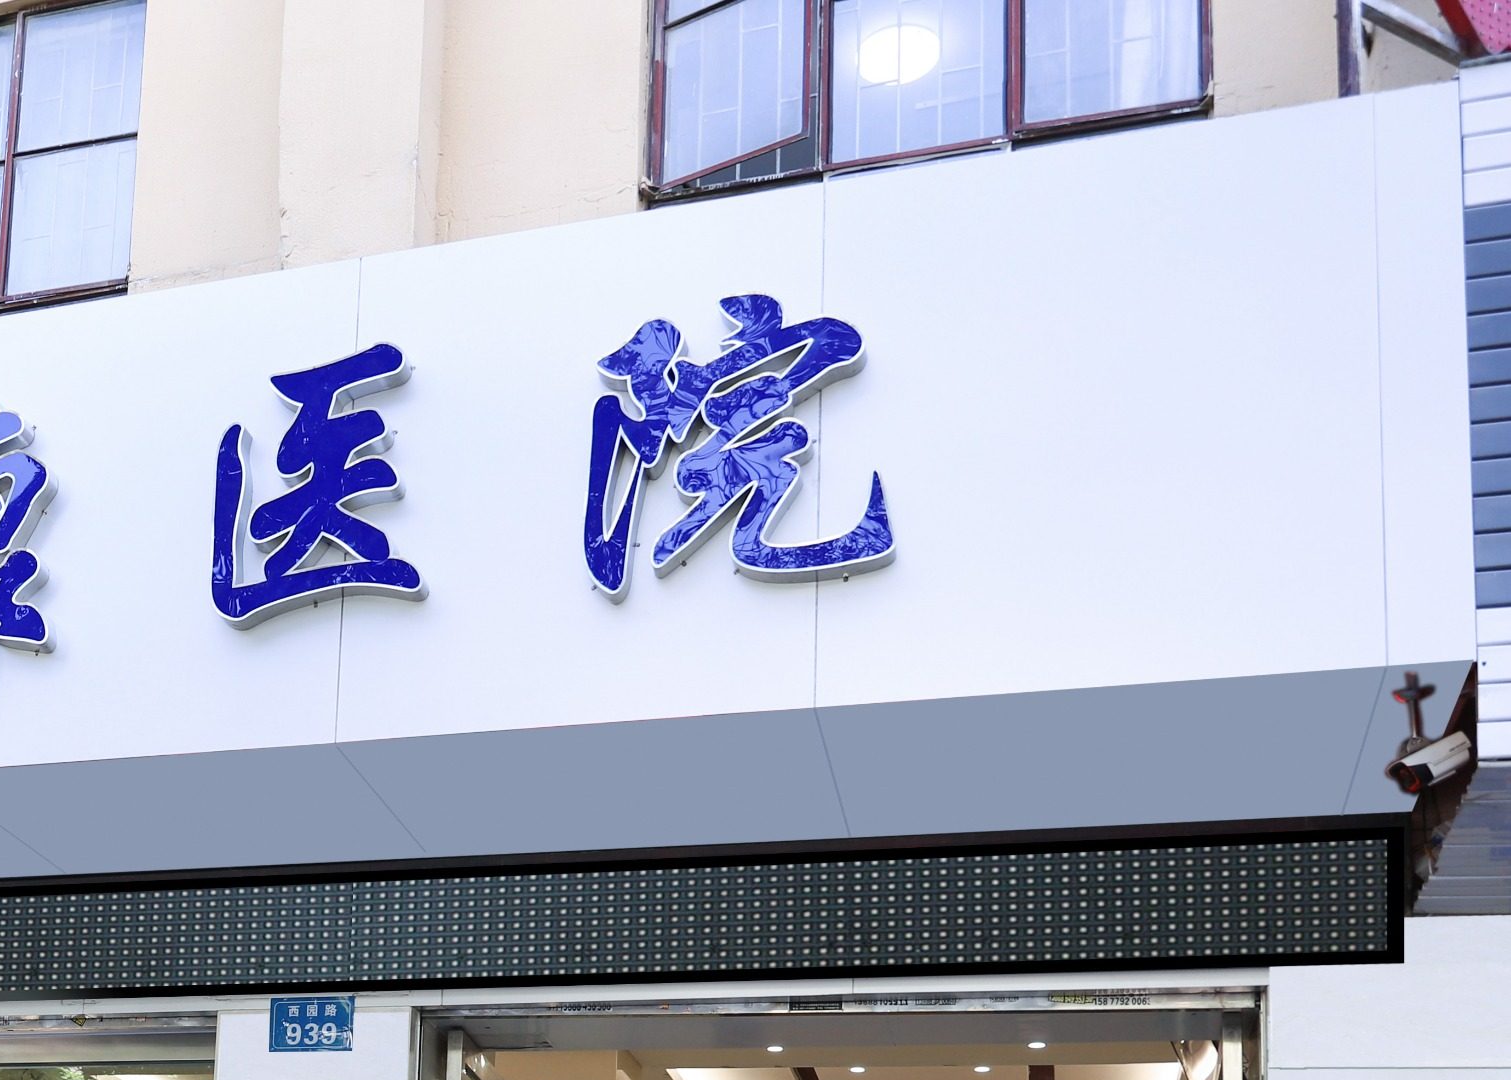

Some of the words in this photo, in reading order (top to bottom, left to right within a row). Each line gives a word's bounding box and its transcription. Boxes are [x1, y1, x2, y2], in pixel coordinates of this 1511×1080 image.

[287, 1004, 337, 1017] 西园路
[286, 1022, 337, 1046] 939
